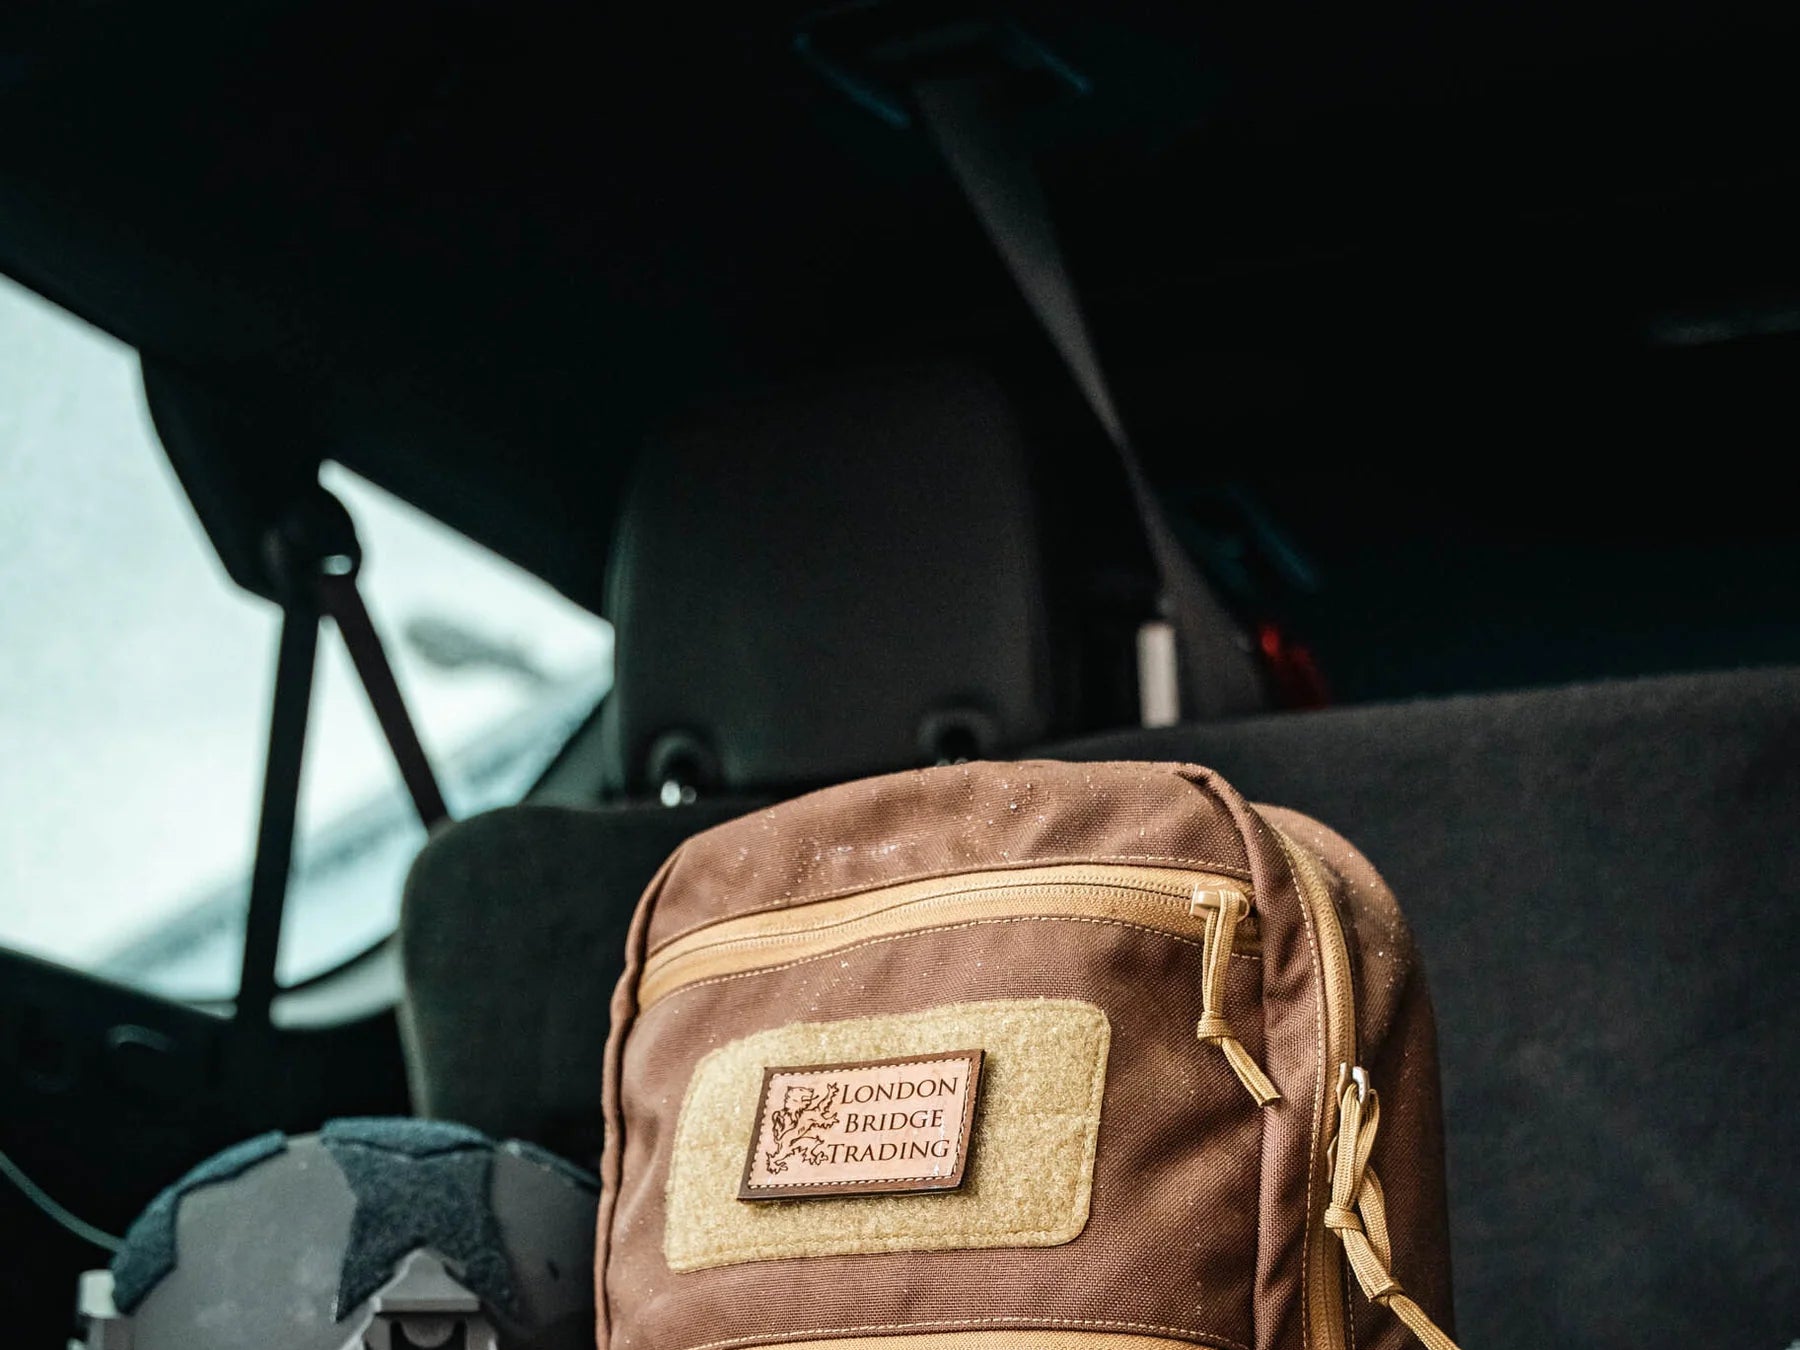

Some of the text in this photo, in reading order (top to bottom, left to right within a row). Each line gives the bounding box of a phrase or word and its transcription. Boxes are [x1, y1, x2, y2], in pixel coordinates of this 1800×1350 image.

[840, 1077, 958, 1105] LONDON
[844, 1109, 944, 1134] BRIDGE
[827, 1139, 950, 1164] TRADING
